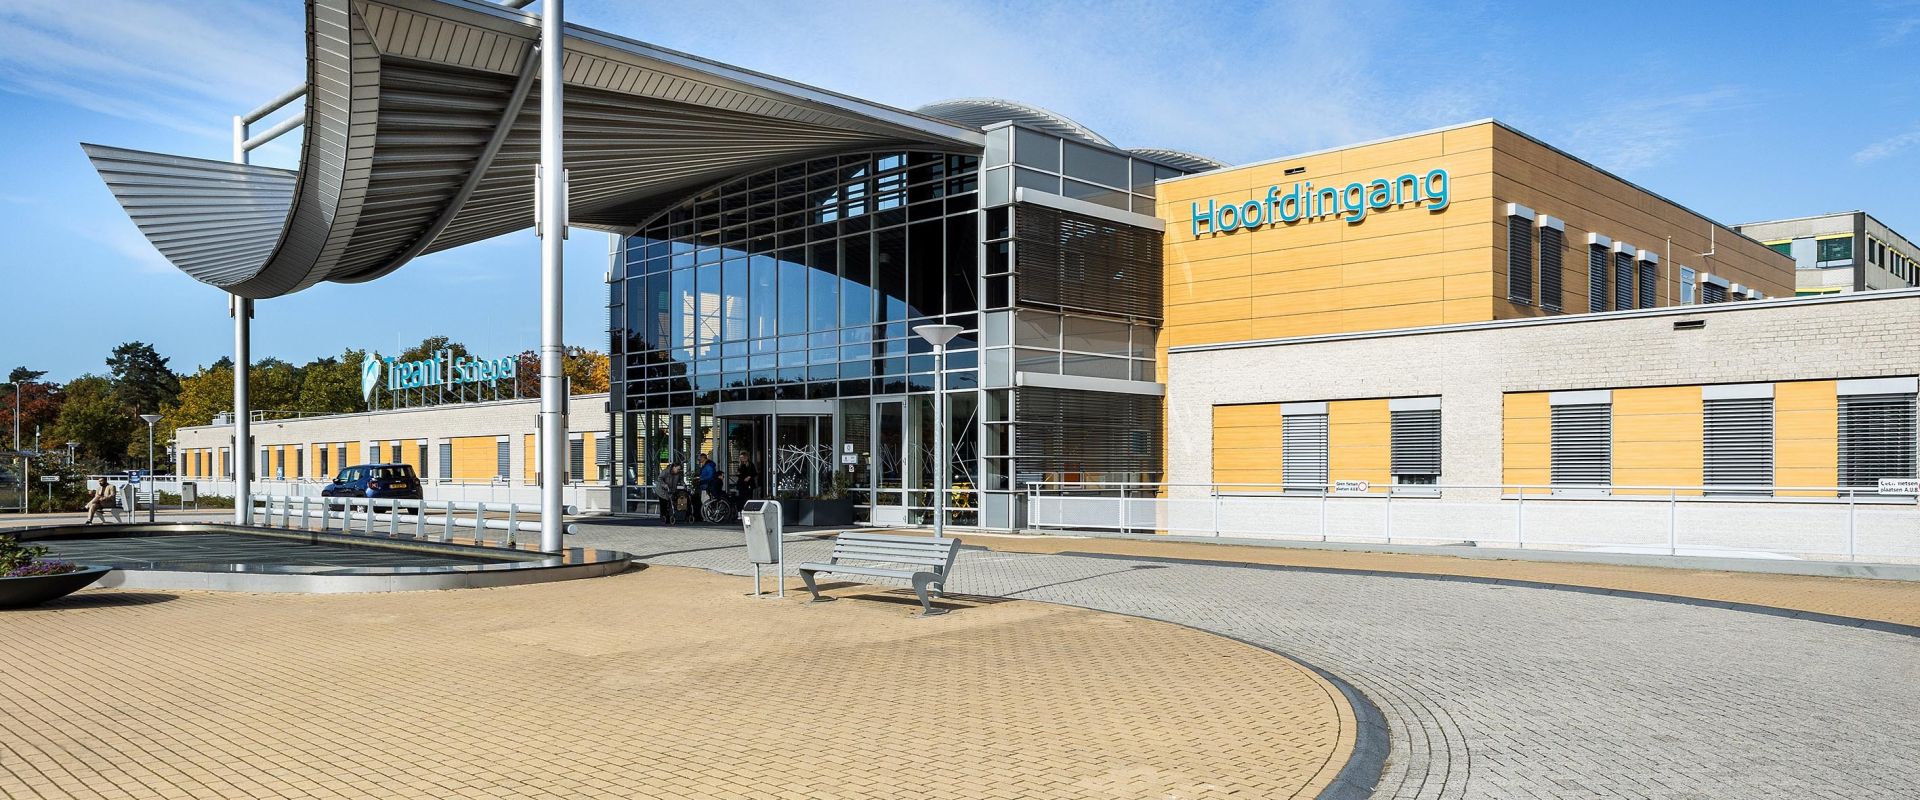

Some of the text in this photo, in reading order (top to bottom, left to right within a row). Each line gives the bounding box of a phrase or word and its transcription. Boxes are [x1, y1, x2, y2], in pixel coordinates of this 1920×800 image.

[1192, 168, 1450, 235] Hoofdingang
[383, 350, 518, 391] Treant Scheper
